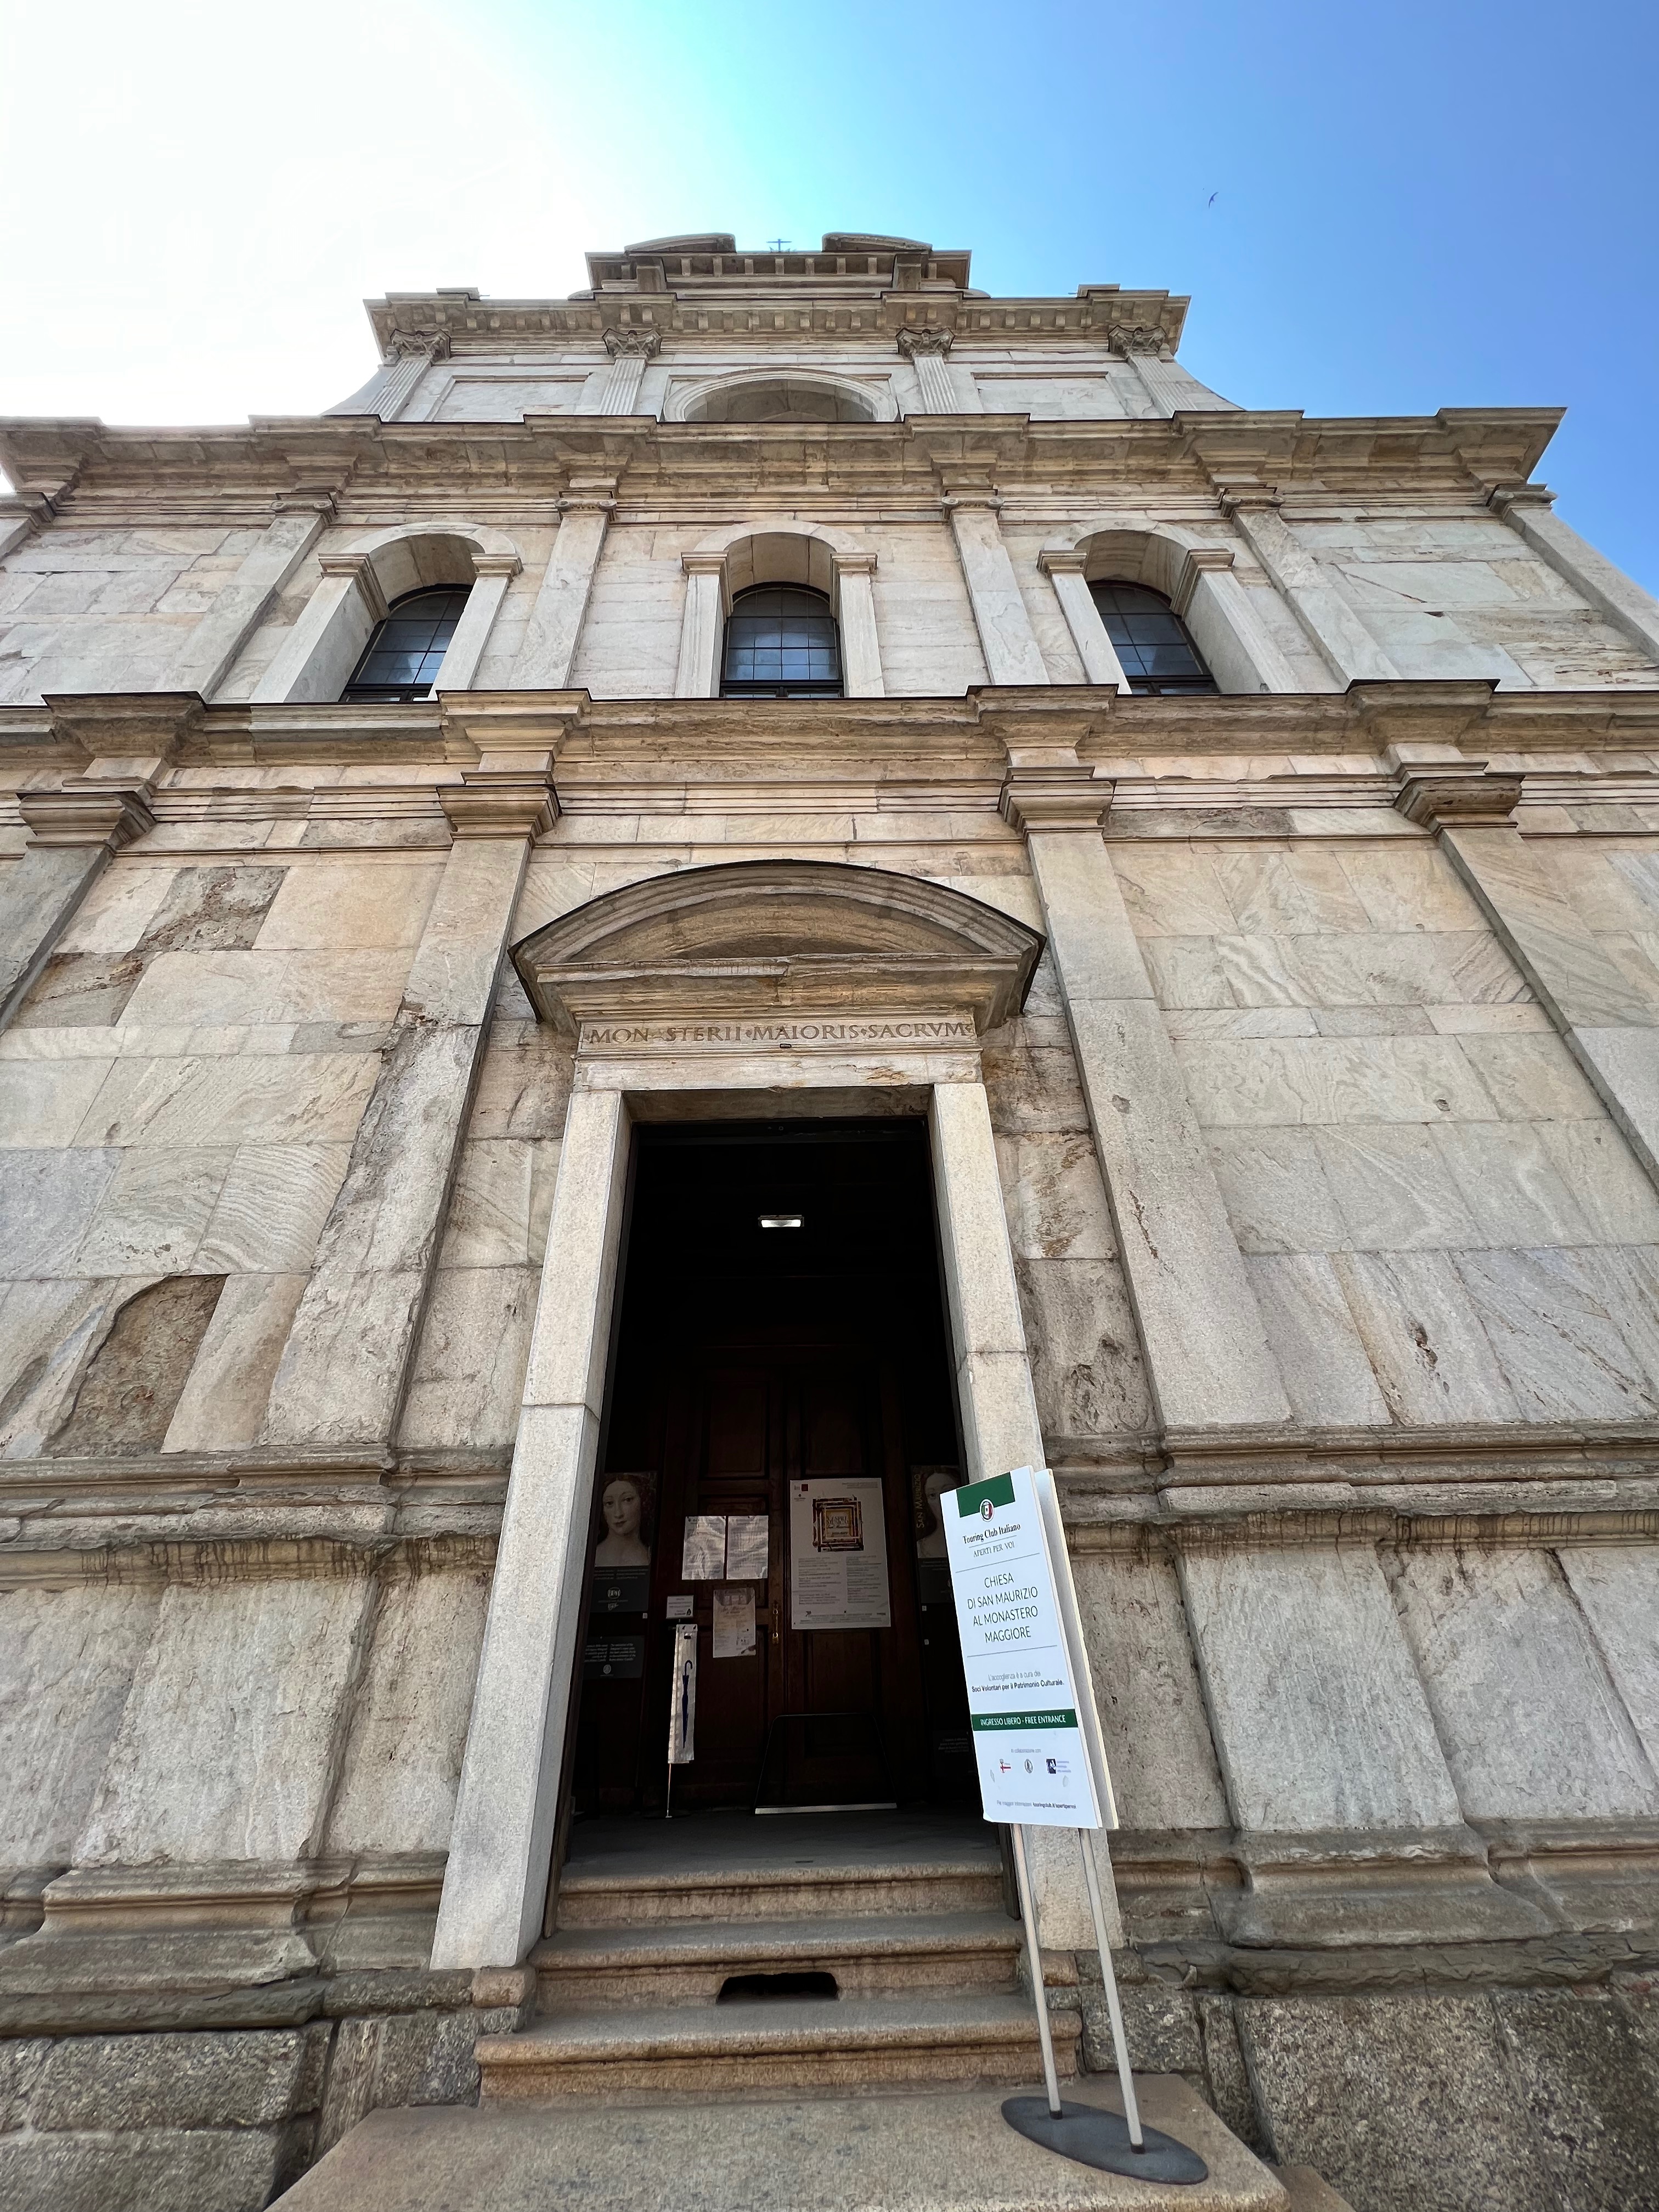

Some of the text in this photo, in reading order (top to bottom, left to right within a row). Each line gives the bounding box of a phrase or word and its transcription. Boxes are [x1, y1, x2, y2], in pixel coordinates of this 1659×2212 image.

[589, 1022, 968, 1044] MONSTERII MAIORIS SACRVM
[963, 1523, 1021, 1544] Touring Club Italiano
[973, 1541, 1015, 1558] APERTI PER VOI
[984, 1572, 1014, 1588] CHIESA
[967, 1586, 1038, 1610] DI SAN MAURIZIO
[973, 1605, 1038, 1627] AL MONASTERO
[984, 1626, 1031, 1643] MAGGIORE
[1014, 1680, 1040, 1689] Patrimonio
[980, 1718, 1003, 1726] INGRESSO
[1003, 1717, 1022, 1725] LIBERO
[1024, 1716, 1037, 1725] FREE
[1037, 1714, 1066, 1724] ENTRANCE
